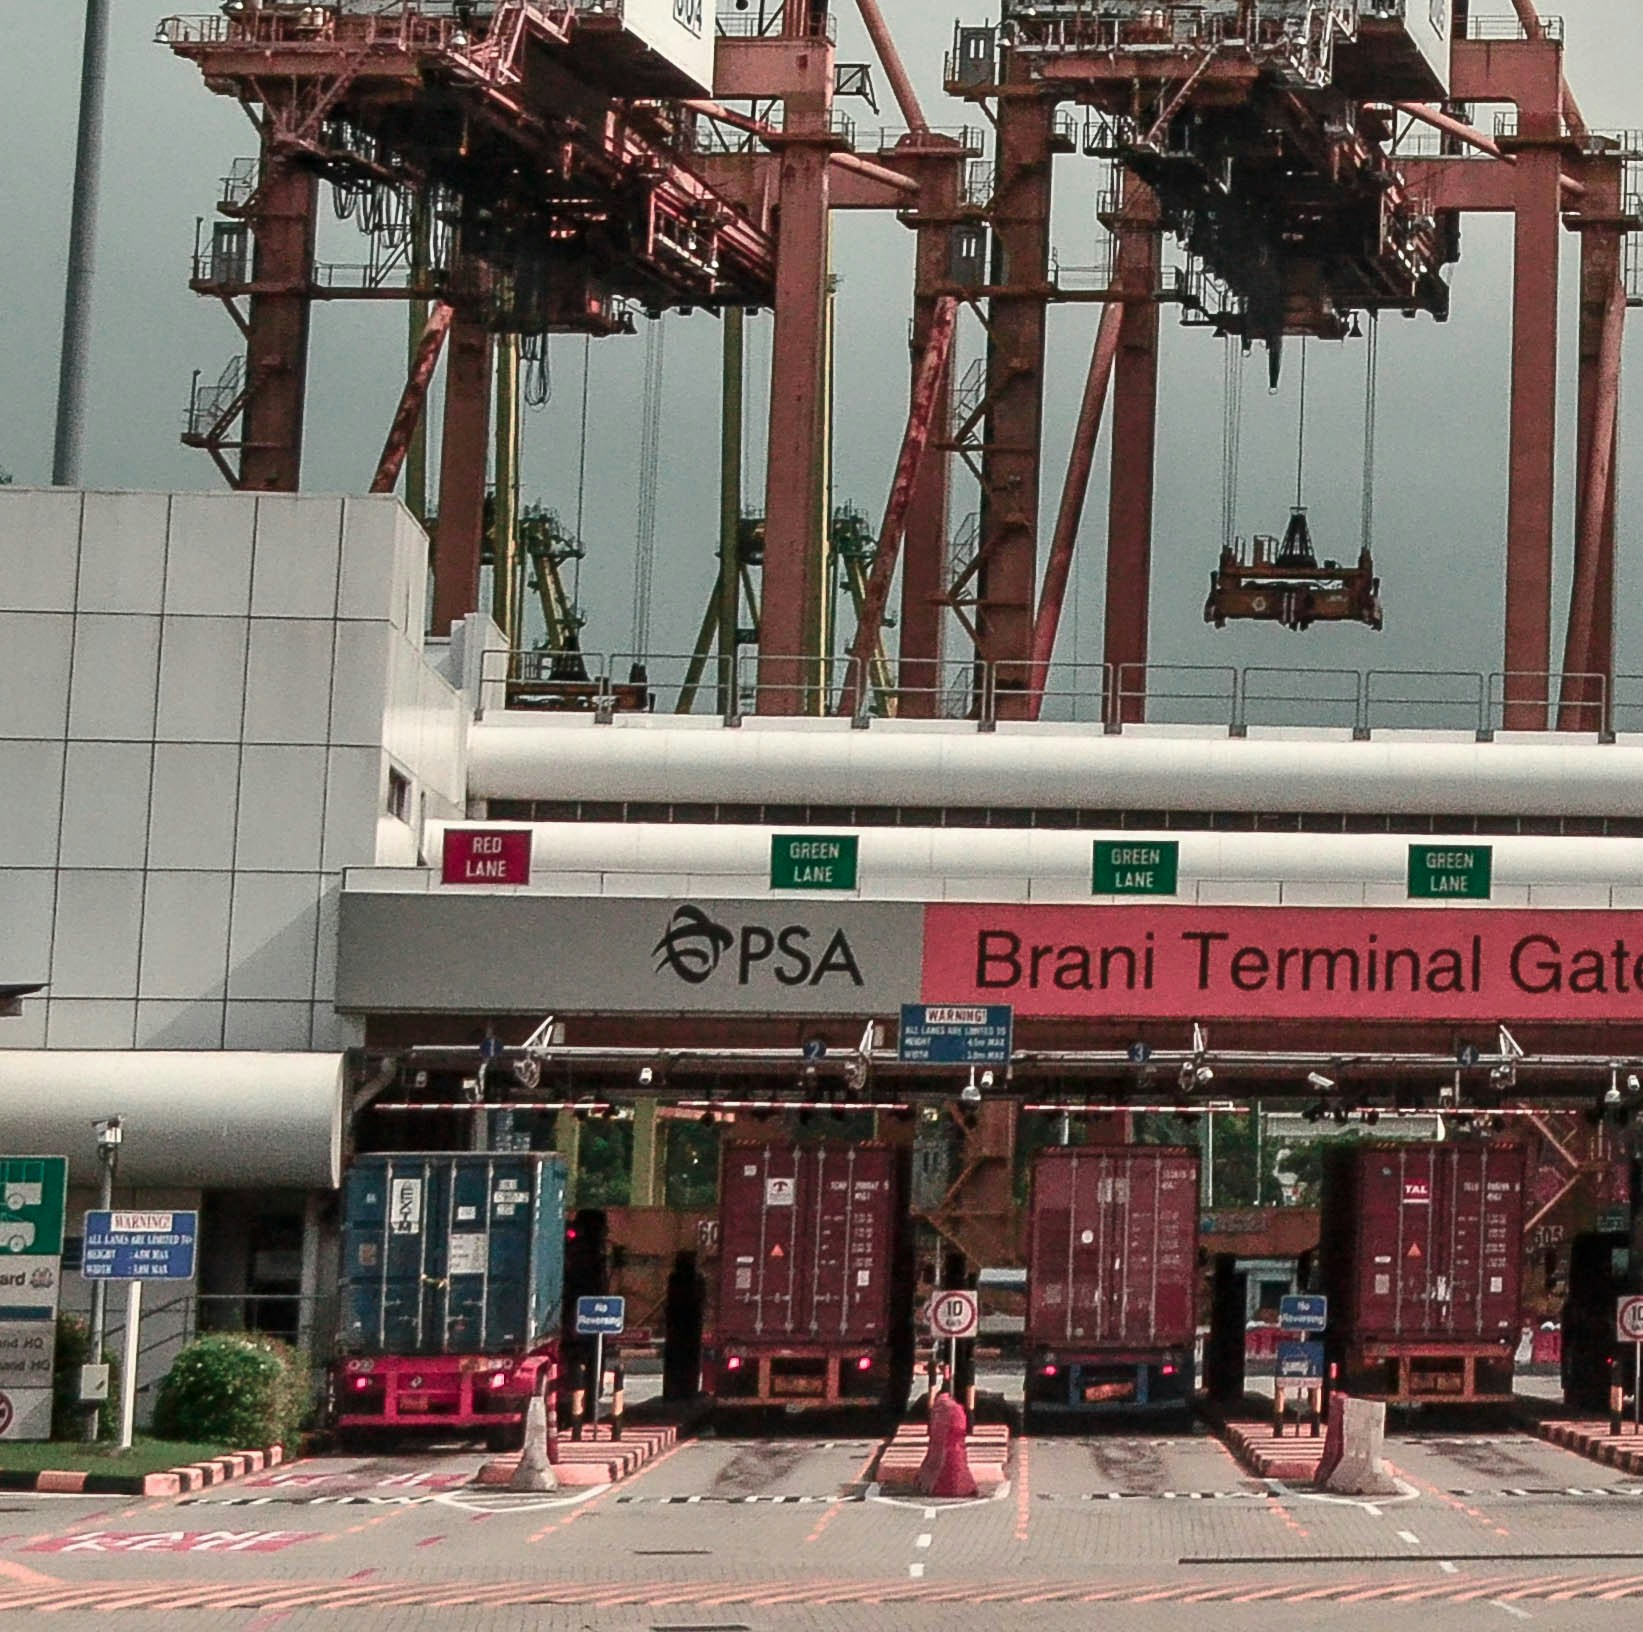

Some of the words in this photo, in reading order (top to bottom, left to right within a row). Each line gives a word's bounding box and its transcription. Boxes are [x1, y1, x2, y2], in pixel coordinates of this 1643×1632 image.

[473, 836, 502, 854] RED
[789, 842, 840, 859] GREEN
[1111, 848, 1160, 865] GREEN
[1426, 852, 1475, 869] GREEN
[466, 860, 507, 878] LANE
[793, 866, 834, 883] LANE
[1115, 871, 1154, 888] LANE
[1430, 875, 1469, 892] LANE
[737, 924, 865, 987] PSA
[975, 929, 1155, 990] Brani
[1181, 930, 1482, 994] Terminal
[928, 1008, 985, 1022] WARNING!
[1133, 1038, 1145, 1058] 3
[1461, 1046, 1472, 1065] 4
[1405, 1184, 1429, 1194] TAL
[0, 1272, 26, 1286] ard
[947, 1300, 963, 1317] 10
